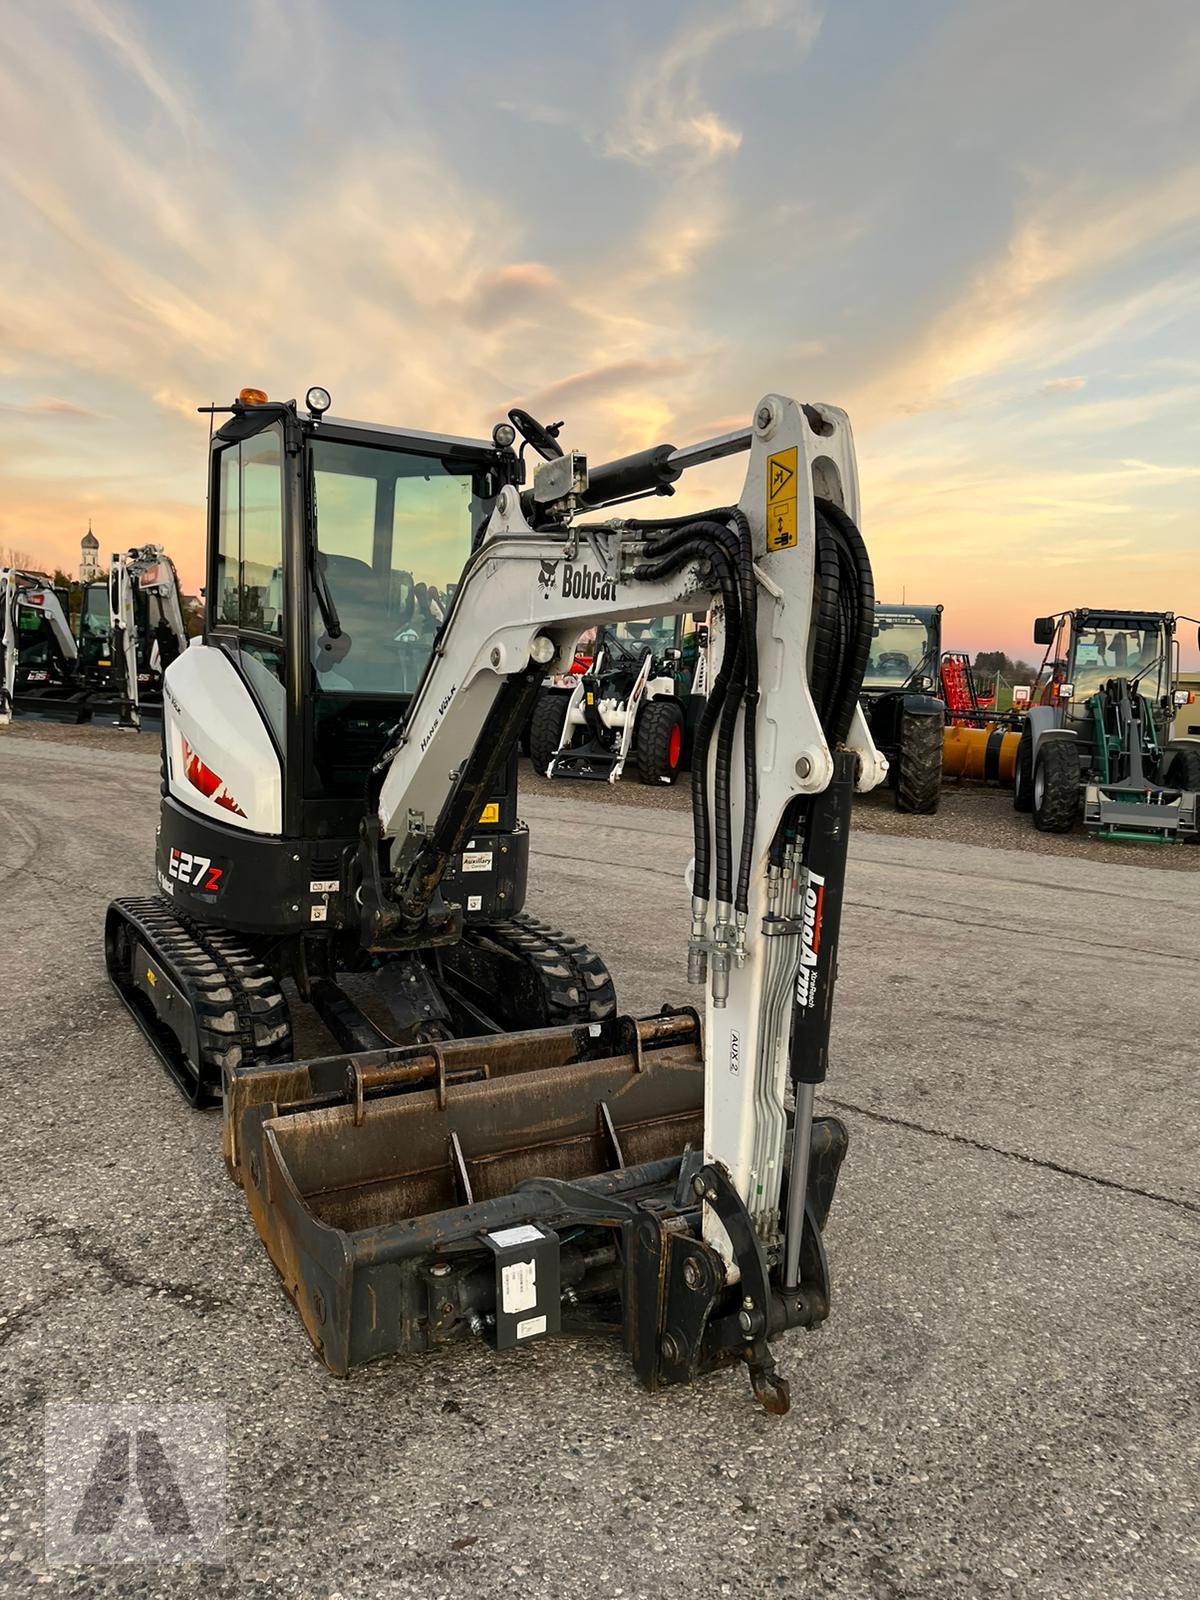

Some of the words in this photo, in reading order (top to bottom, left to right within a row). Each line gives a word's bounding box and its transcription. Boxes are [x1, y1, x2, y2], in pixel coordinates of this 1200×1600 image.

[561, 563, 617, 602] Bobcat
[796, 869, 825, 1008] LongArm
[731, 1033, 739, 1061] AUX
[729, 1063, 739, 1072] 2
